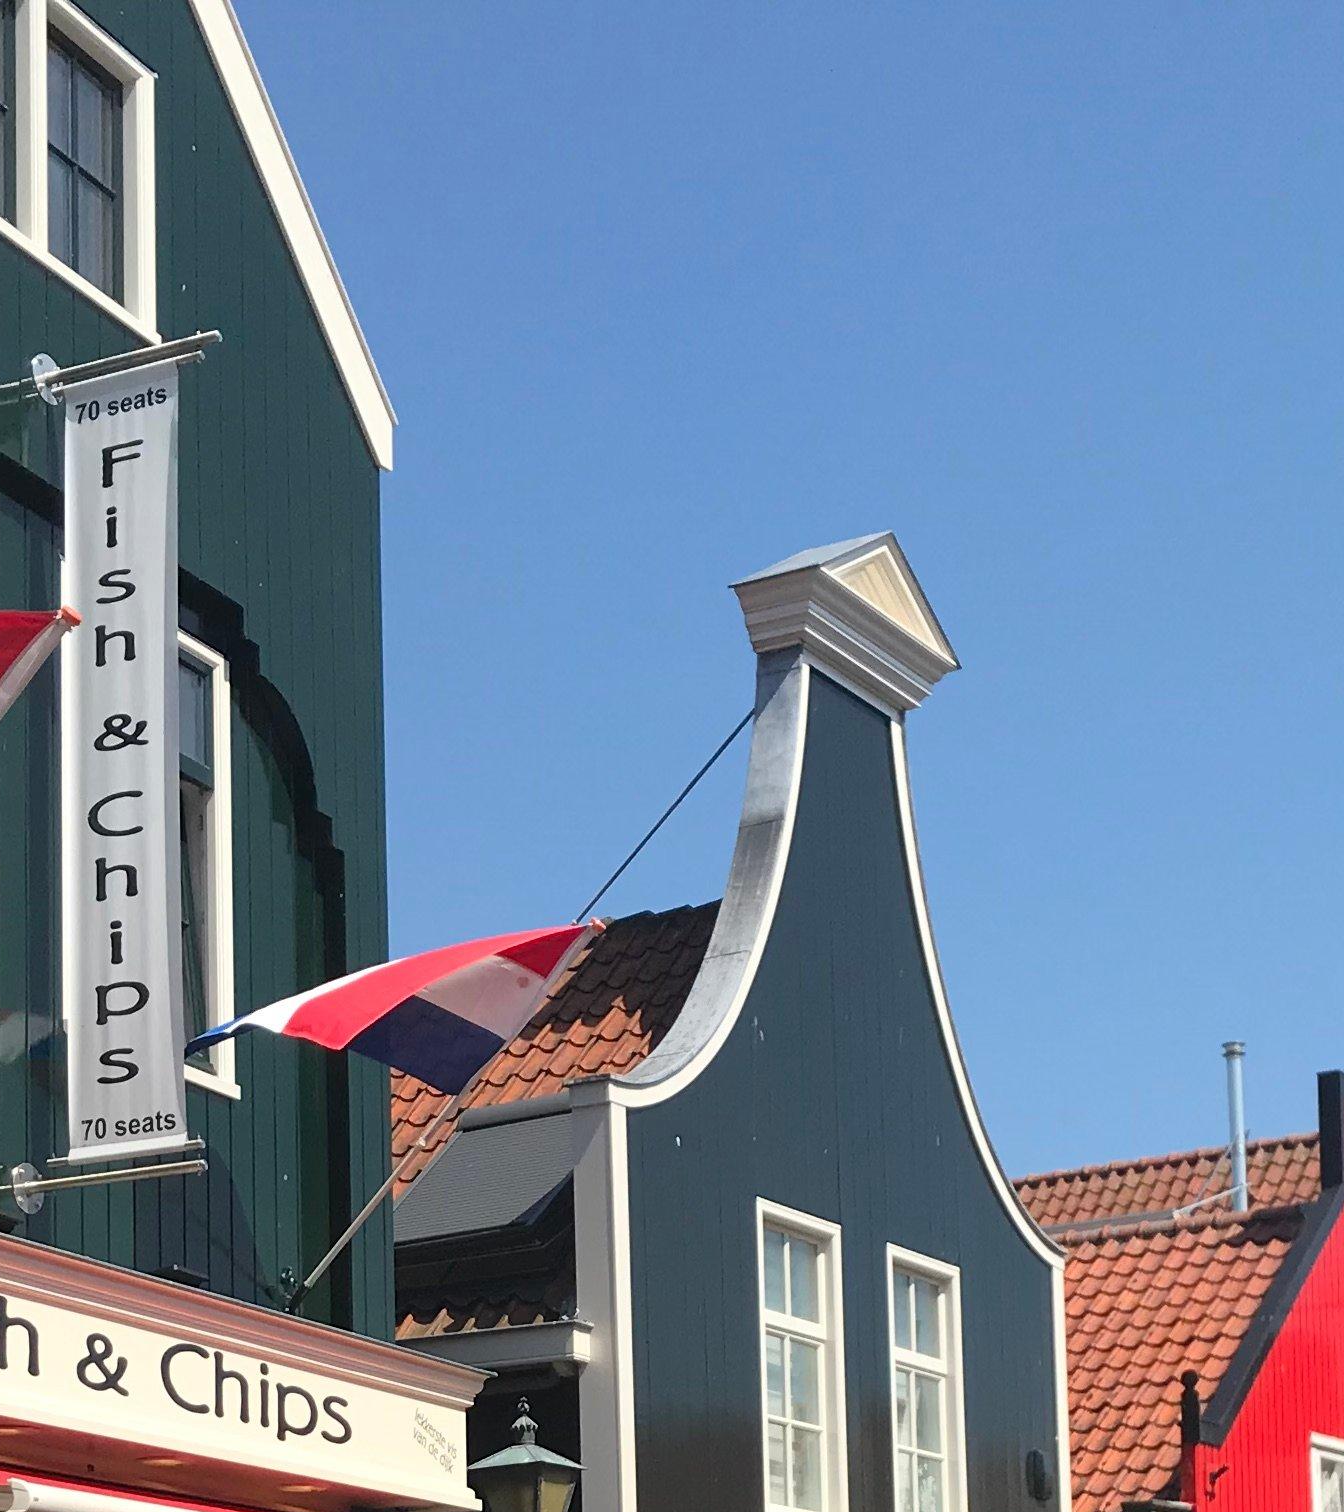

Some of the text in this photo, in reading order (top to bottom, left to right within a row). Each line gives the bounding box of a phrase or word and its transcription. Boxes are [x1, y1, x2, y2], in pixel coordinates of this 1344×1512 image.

[75, 385, 167, 425] 70 seats
[94, 713, 149, 751] &
[81, 1110, 176, 1141] 70 seats
[76, 1332, 130, 1397] &
[160, 1343, 353, 1447] Chips
